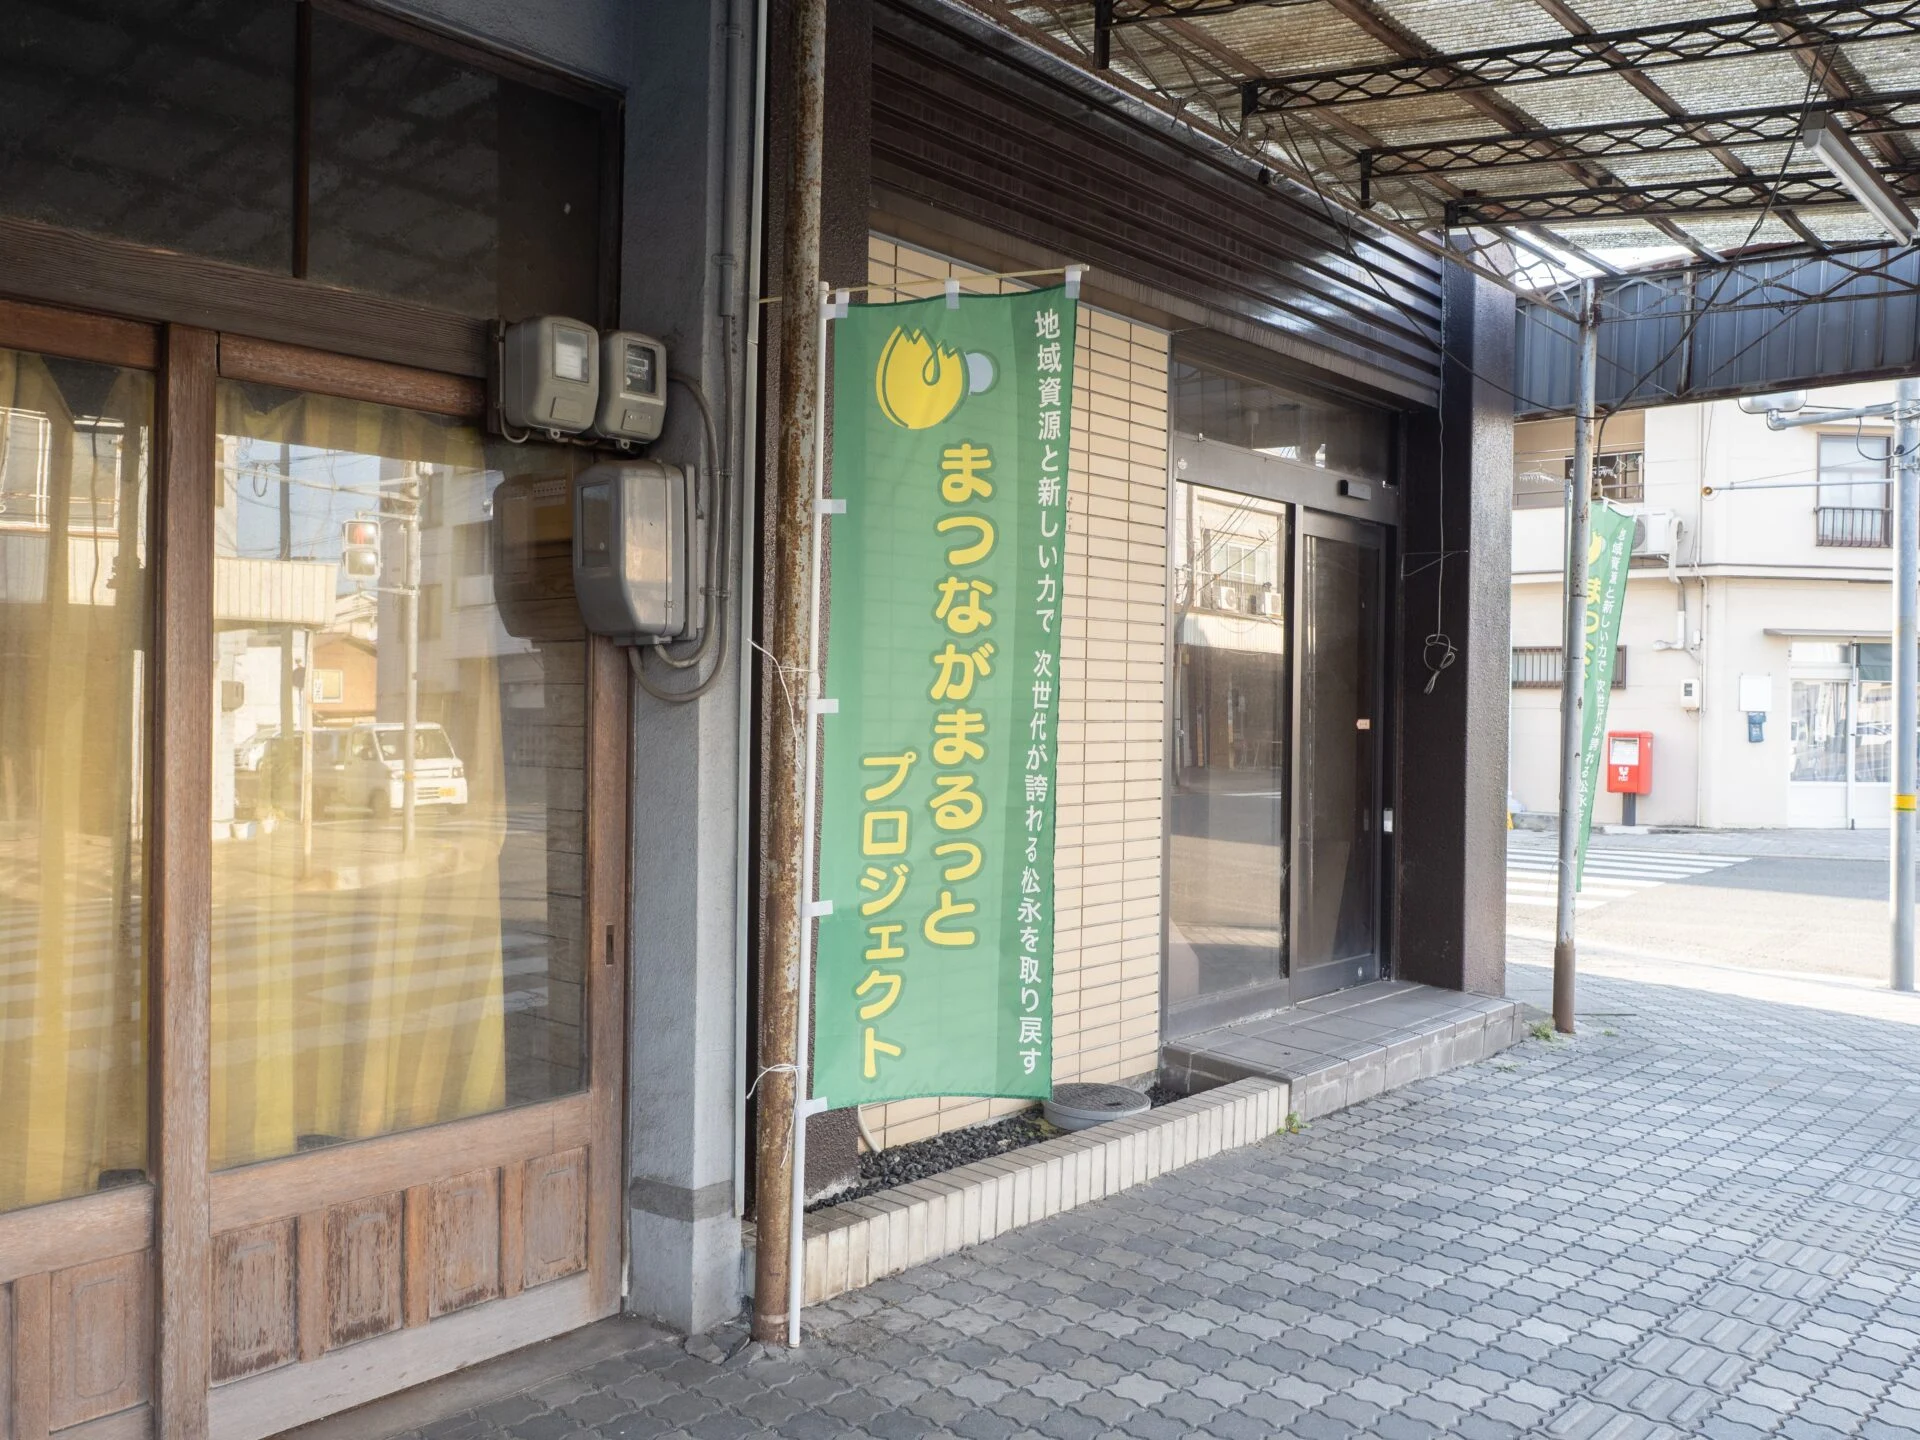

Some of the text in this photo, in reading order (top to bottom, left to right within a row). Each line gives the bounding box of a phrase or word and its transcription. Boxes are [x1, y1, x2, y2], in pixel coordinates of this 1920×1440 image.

[855, 750, 918, 1080] プロジェクト
[923, 442, 996, 947] まつながまるっと
[1017, 308, 1062, 1077] 地域資源と新しい力で 次世代が誇れる松永を取り戻す
